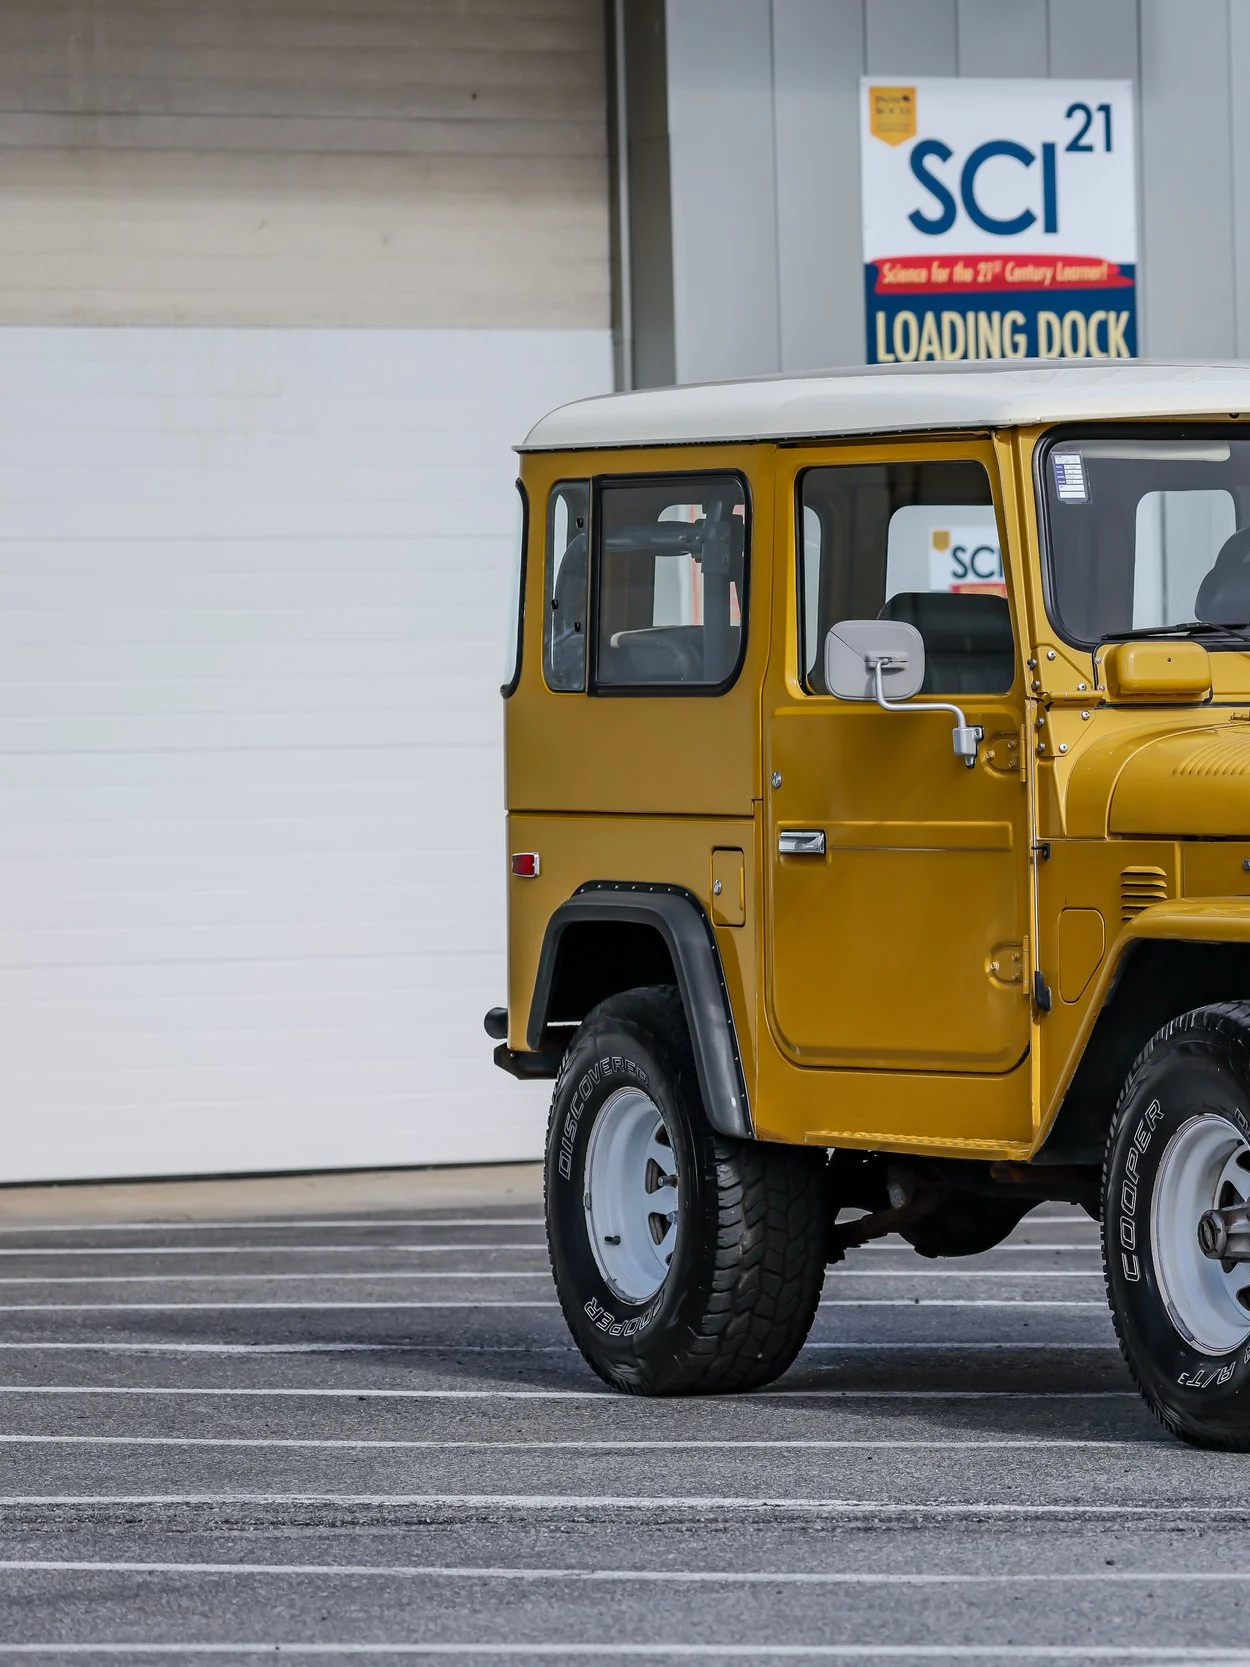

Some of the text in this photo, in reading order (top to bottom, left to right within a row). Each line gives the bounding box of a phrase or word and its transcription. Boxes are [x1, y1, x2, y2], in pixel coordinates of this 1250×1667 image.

[908, 102, 1112, 235] SCI 21
[876, 310, 1131, 363] LOADING DOCK
[882, 262, 928, 284] Science
[931, 260, 950, 283] for
[953, 260, 974, 283] the
[1005, 261, 1054, 288] Century
[558, 1056, 650, 1181] DISCOVERER
[1119, 1099, 1165, 1281] COOPER
